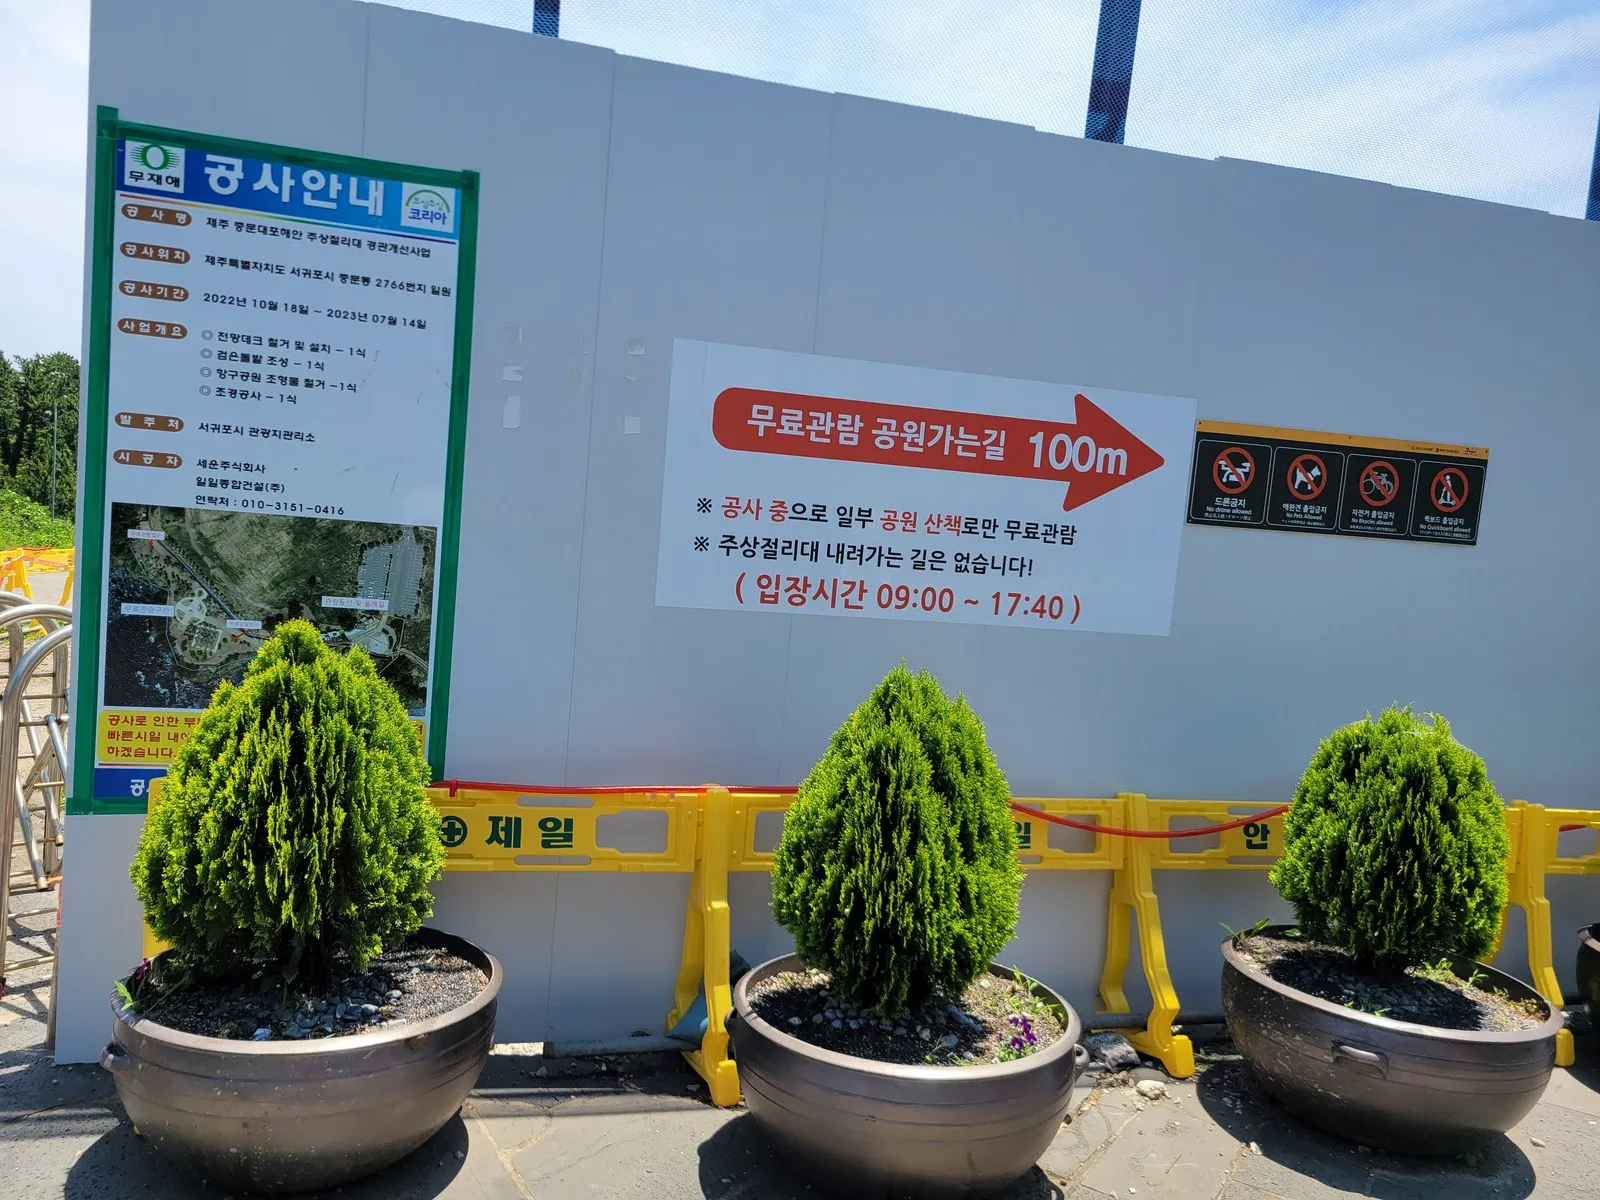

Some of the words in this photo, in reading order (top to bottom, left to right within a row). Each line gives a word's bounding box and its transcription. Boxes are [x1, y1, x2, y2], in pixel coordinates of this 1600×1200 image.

[129, 170, 180, 188] 무재해
[204, 154, 385, 217] 공사안내
[408, 208, 447, 225] 코리아
[206, 217, 230, 230] 제주
[234, 221, 303, 240] 중문대포해안
[306, 231, 362, 248] 주상절리대
[366, 240, 431, 258] 경관개선사업
[124, 244, 186, 262] 공사위치
[204, 254, 286, 275] 제주특별자치도
[290, 266, 334, 282] 서귀포시
[339, 273, 371, 287] 중문동
[375, 278, 427, 294] 2766번지
[430, 285, 452, 298] 일원
[124, 282, 186, 300] 공사기간
[203, 293, 247, 308] 2022년
[252, 298, 278, 312] 10월
[283, 303, 310, 315] 18일
[326, 308, 368, 323] 2023년
[372, 314, 398, 326] 07월
[402, 318, 427, 330] 14일
[122, 320, 184, 337] 사업개요
[218, 331, 263, 346] 전망데크
[268, 337, 290, 350] 철거
[294, 340, 305, 352] 및
[309, 343, 332, 354] 설치
[348, 347, 366, 358] 1식
[266, 356, 289, 368] 조성
[306, 360, 325, 372] 1식
[304, 378, 326, 390] 철거
[215, 386, 262, 401] 조경공사
[279, 394, 298, 405] 1식
[198, 422, 244, 436] 서귀포시
[248, 426, 316, 443] 관광지관리소
[747, 403, 864, 446] 무료관람
[871, 416, 1007, 462] 공원가는길
[1028, 430, 1128, 476] 100m
[196, 458, 266, 474] 세운주식회사
[196, 476, 286, 494] 일일종합건설(주)
[195, 495, 230, 508] 연락처
[241, 499, 345, 516] 010-3151-0416
[1214, 497, 1246, 508] 드론금지
[1215, 506, 1231, 514] drone
[1232, 508, 1252, 516] allowed
[1282, 503, 1302, 512] 애완견
[1302, 504, 1328, 514] 출입금지
[721, 496, 763, 521] 공사
[768, 500, 829, 524] 중으로
[836, 506, 874, 529] 일부
[880, 509, 918, 534] 공원
[924, 513, 999, 540] 산책로만
[1004, 520, 1078, 546] 무료관람
[1352, 508, 1370, 518] 자전거
[1371, 510, 1395, 520] 출입금지
[1442, 516, 1465, 526] 출입금지
[1427, 524, 1453, 532] Quickboard
[718, 534, 820, 563] 주상절리대
[826, 542, 904, 569] 내려가는
[910, 548, 947, 572] 길은
[954, 552, 1034, 578] 없습니다!
[756, 573, 869, 610] 입장시간
[876, 582, 955, 613] 09:00
[991, 590, 1064, 620] 17:40
[108, 714, 148, 727] 공사로
[153, 715, 179, 728] 인한
[184, 716, 200, 728] 부
[106, 730, 161, 743] 빠른시일
[129, 778, 149, 797] 공
